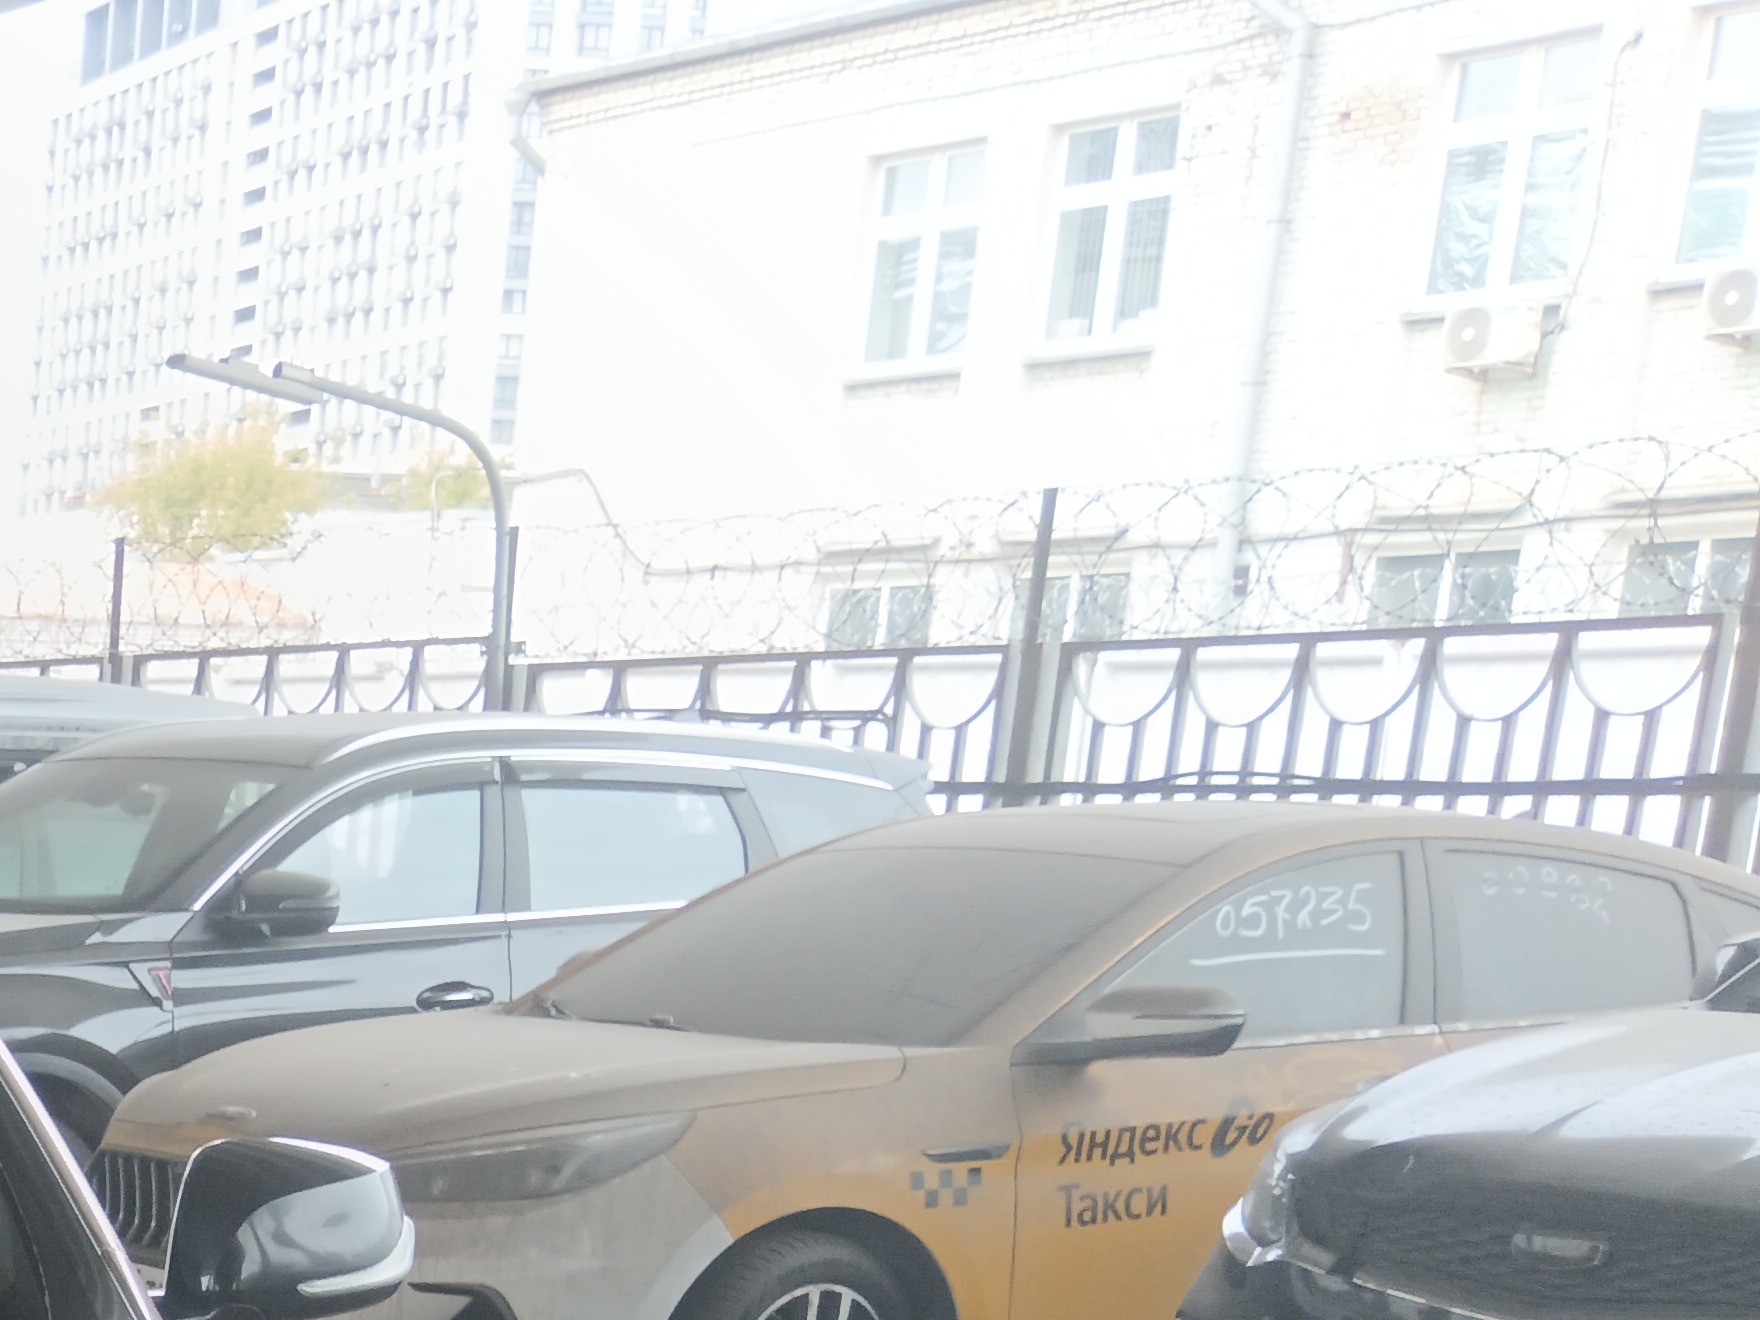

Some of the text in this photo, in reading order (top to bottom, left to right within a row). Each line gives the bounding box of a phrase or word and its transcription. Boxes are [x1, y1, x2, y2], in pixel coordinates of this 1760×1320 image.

[1057, 1097, 1275, 1167] Яндекс Go
[1057, 1184, 1169, 1228] Такси
